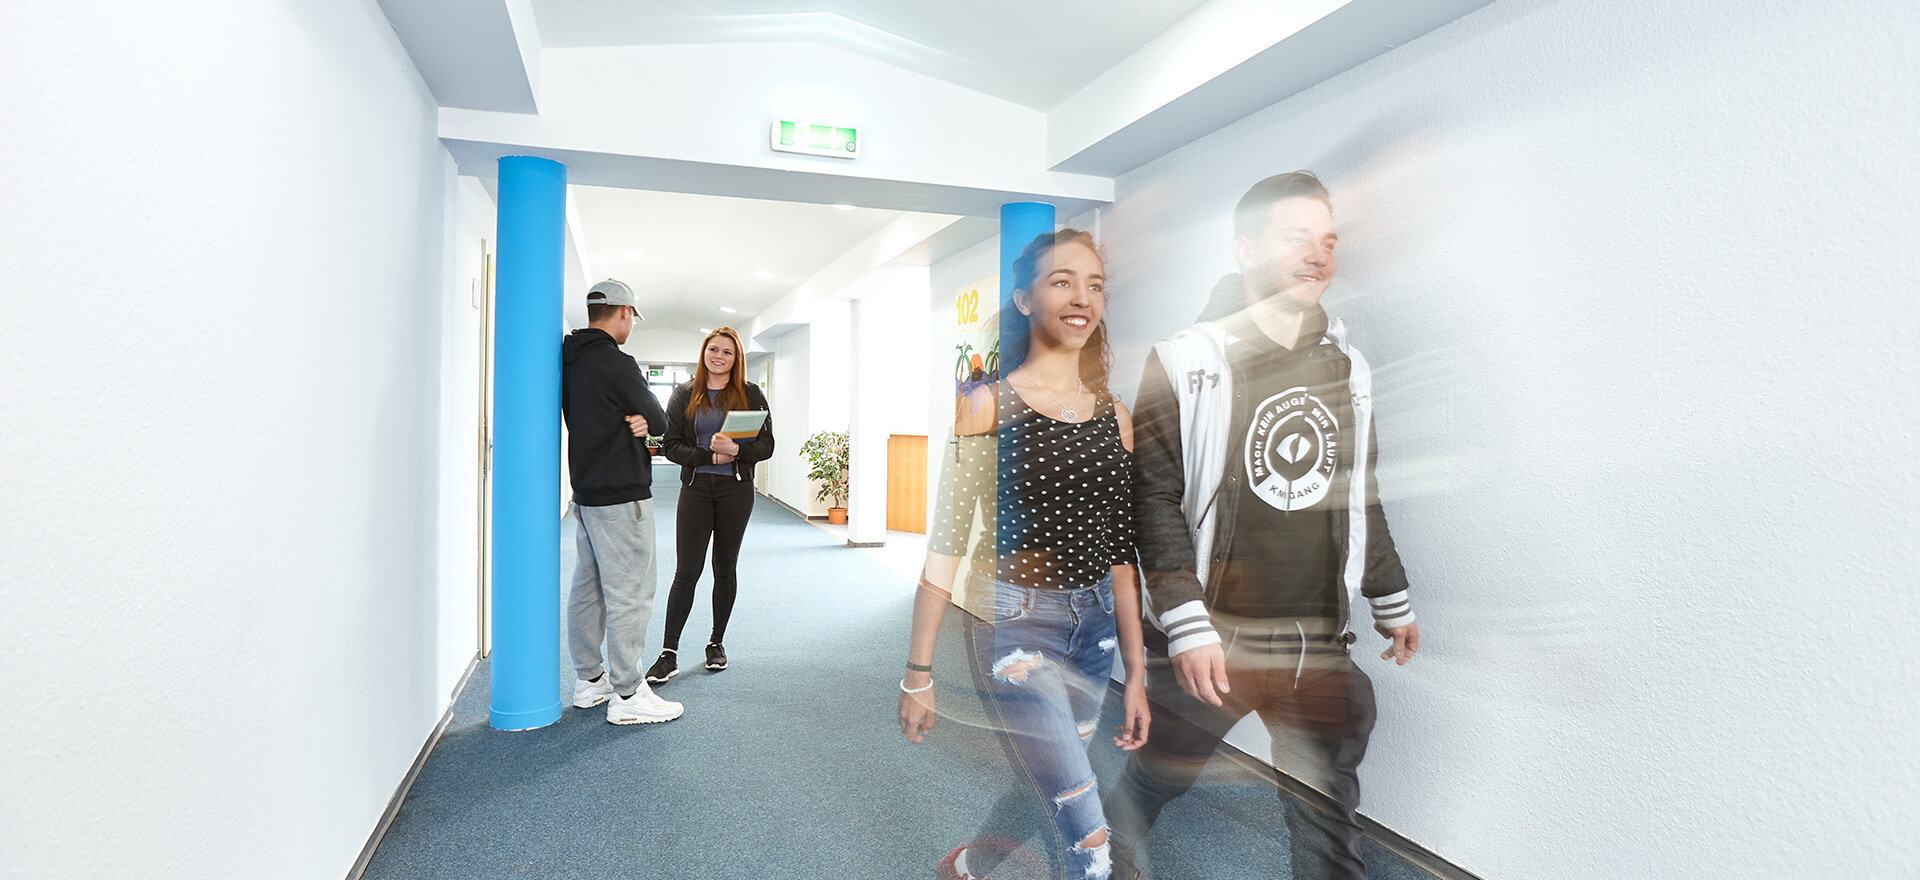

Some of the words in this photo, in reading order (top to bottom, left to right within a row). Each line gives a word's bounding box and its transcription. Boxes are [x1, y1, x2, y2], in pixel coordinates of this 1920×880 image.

[956, 289, 978, 326] 102
[1257, 411, 1275, 436] KEIN
[1311, 407, 1329, 429] MIR
[1254, 441, 1265, 477] MACH
